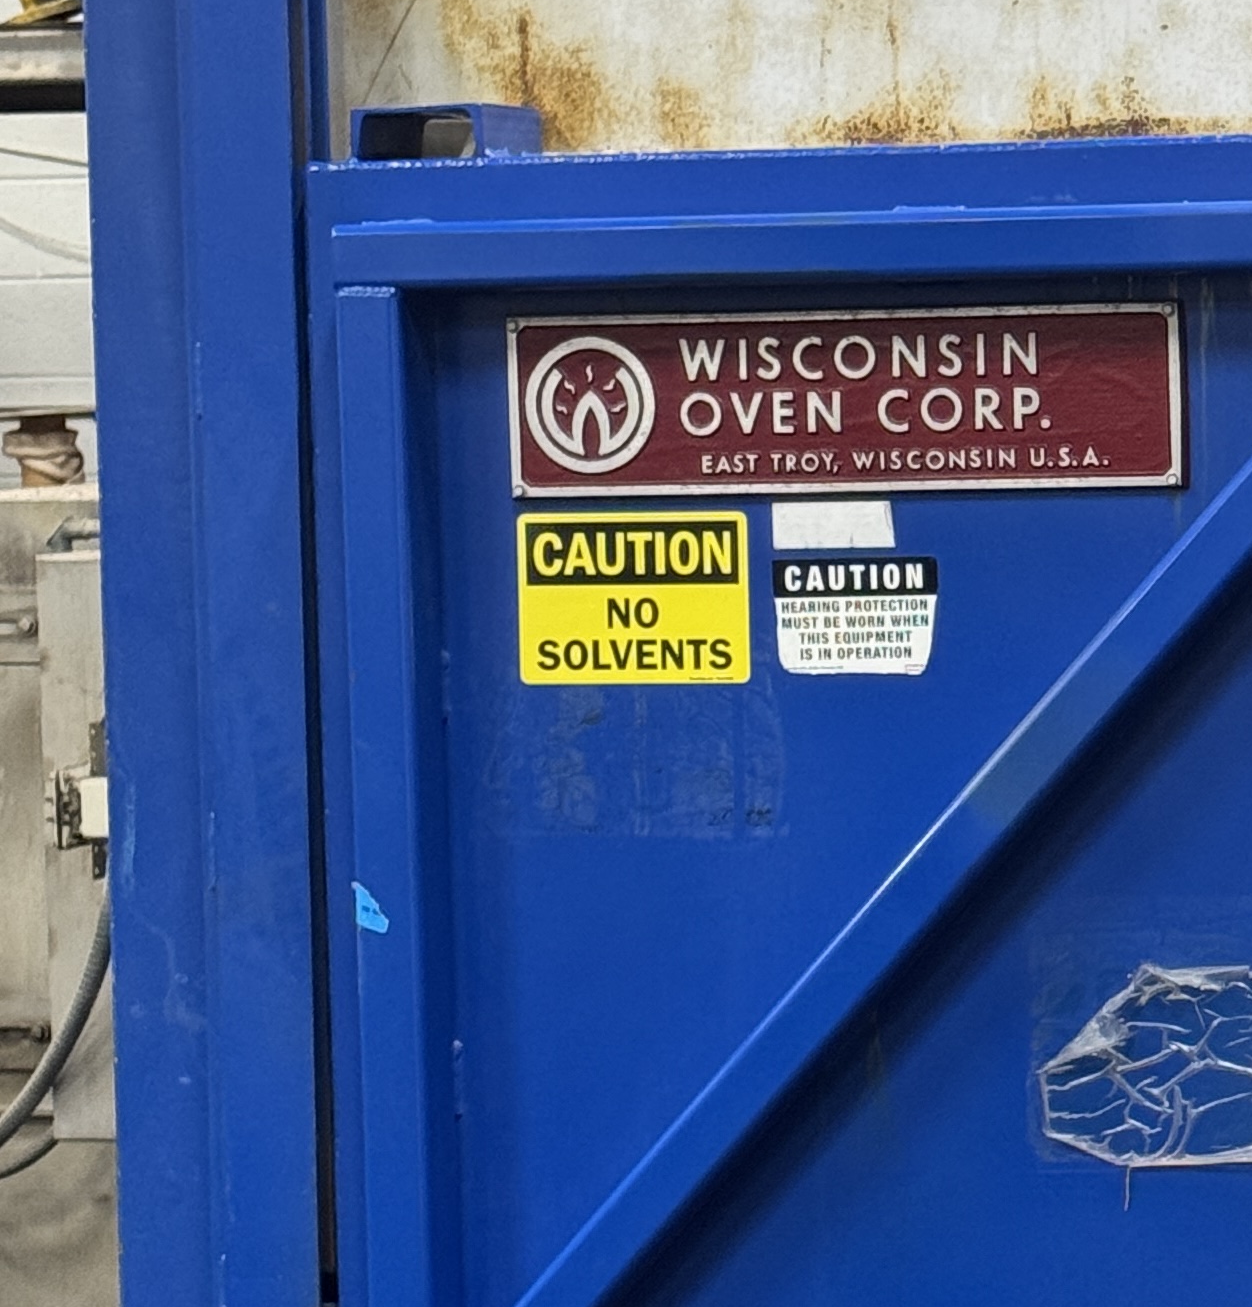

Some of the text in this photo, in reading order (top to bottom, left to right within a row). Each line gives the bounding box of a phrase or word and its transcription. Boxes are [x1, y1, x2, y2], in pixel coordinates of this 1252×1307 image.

[678, 331, 1039, 382] WISCONSIN
[679, 386, 1052, 437] OVEN CORP.
[701, 445, 1111, 475] EAST TROY, WISCONSIN U.S.A.
[532, 529, 733, 577] CAUTION
[783, 562, 924, 592] CAUTION
[606, 597, 660, 629] NO
[780, 597, 929, 614] HEARING PROTECTION
[780, 613, 930, 630] MUST BE WORN WHEN
[798, 629, 913, 645] THIS EQUIPMENT
[536, 638, 733, 671] SOLVENTS
[799, 645, 913, 661] IS IN OPERATION
